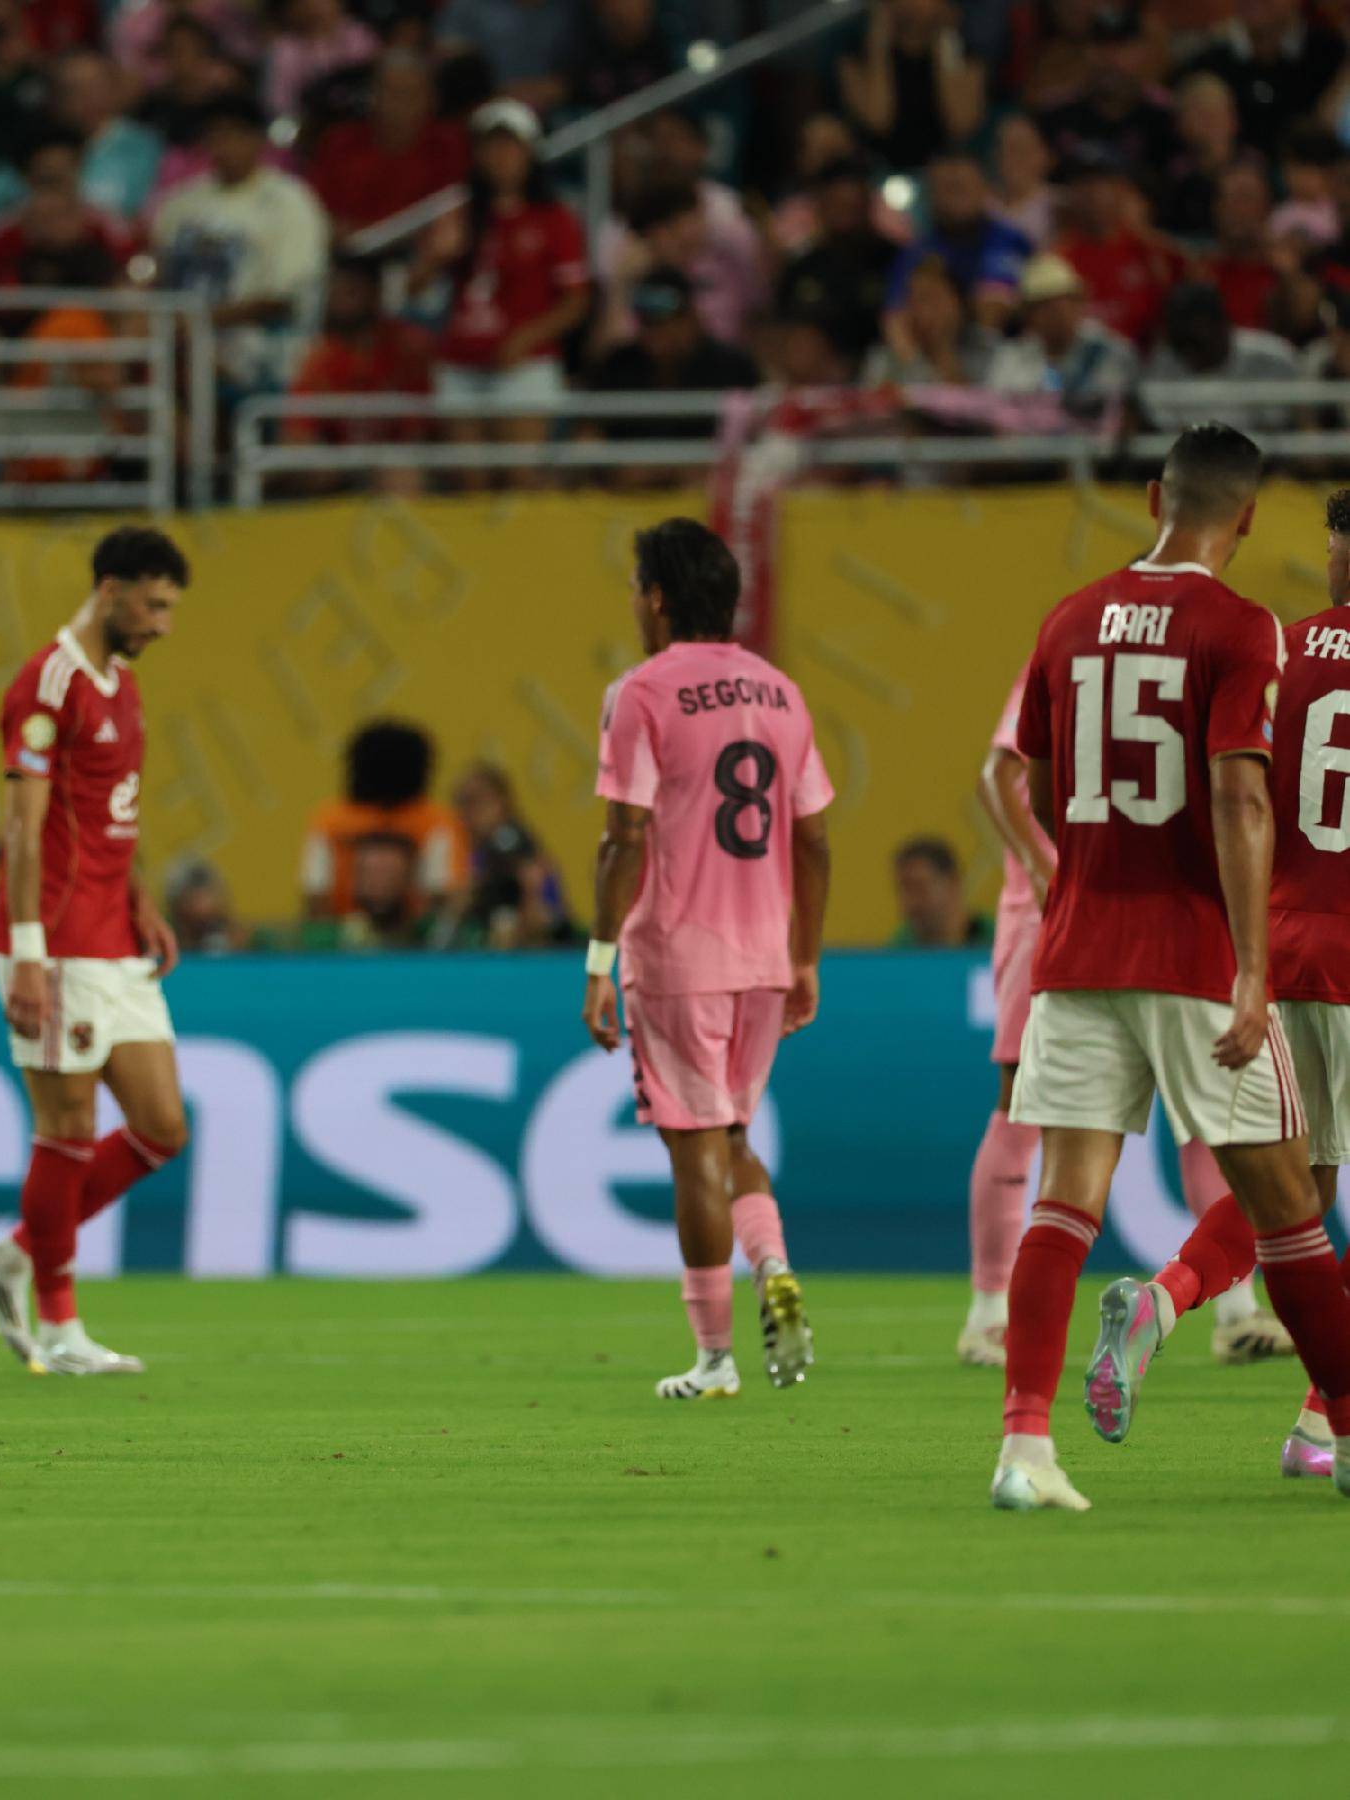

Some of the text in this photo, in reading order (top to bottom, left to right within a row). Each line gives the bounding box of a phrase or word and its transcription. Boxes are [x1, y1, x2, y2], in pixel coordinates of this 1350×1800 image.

[1098, 603, 1174, 646] DARI
[678, 677, 792, 716] SEGOVIA
[1066, 652, 1188, 827] 15
[714, 740, 776, 861] 8
[1298, 689, 1350, 853] 6
